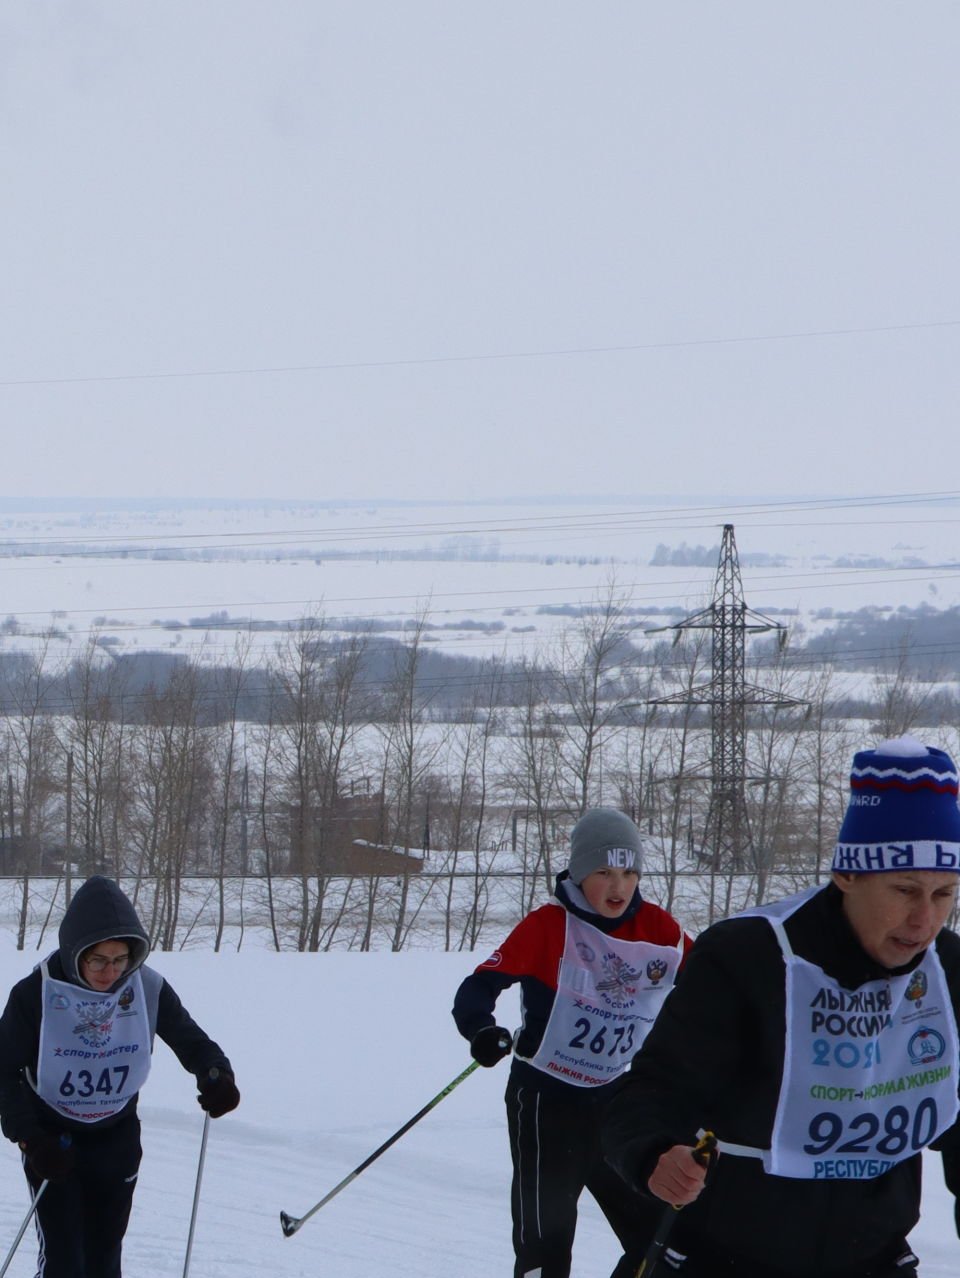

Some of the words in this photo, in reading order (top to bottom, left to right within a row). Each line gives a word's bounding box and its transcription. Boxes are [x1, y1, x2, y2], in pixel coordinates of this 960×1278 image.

[607, 848, 636, 868] NEW
[601, 993, 636, 1009] РОССИИ
[809, 988, 892, 1013] ЛЫЖНЯ
[811, 1011, 892, 1038] РОССИИ
[569, 1017, 635, 1057] 2673
[63, 1043, 139, 1060] спортмастер
[554, 1050, 603, 1071] Республика
[547, 1061, 583, 1080] ЛЫЖНЯ
[905, 1066, 951, 1087] ЖИЗНИ
[59, 1065, 130, 1098] 6347
[803, 1097, 938, 1155] 9280
